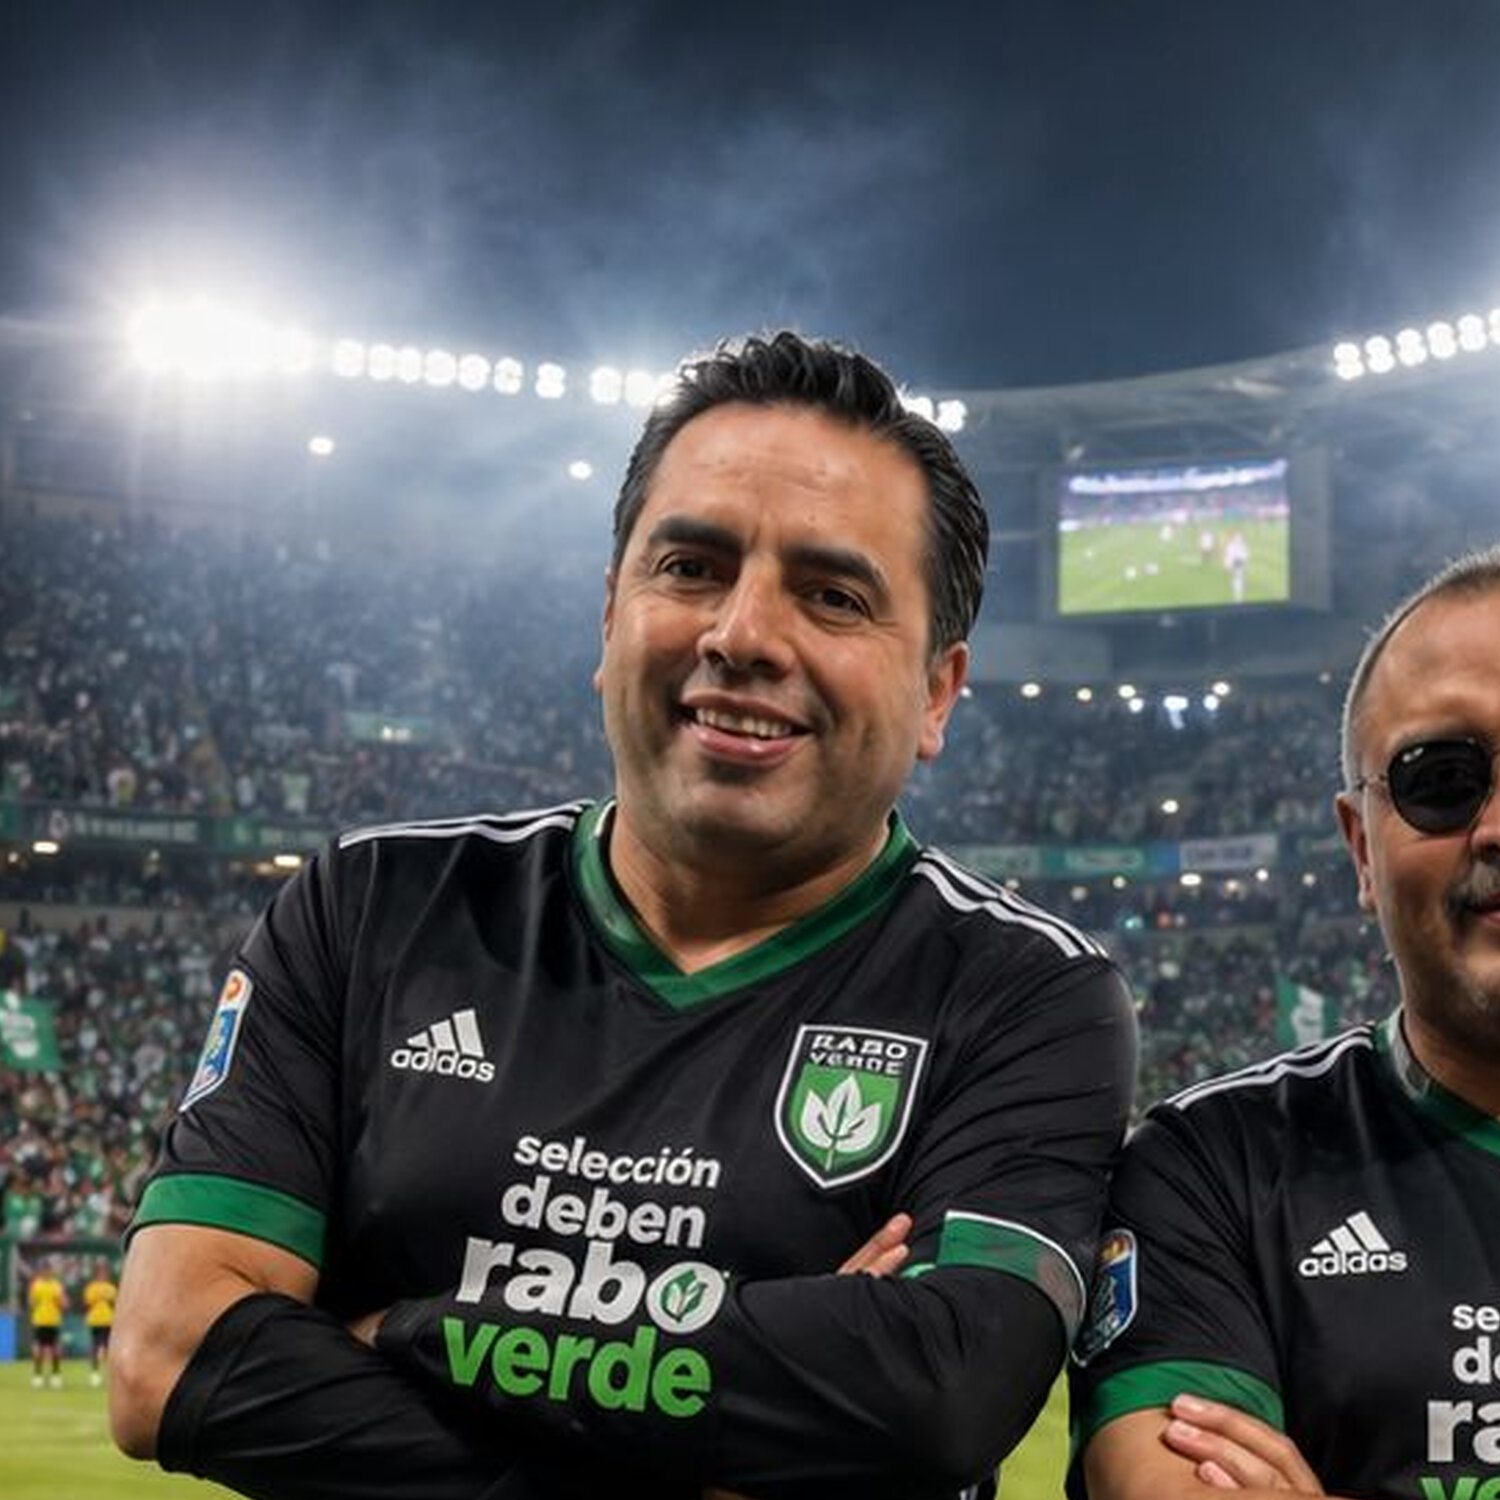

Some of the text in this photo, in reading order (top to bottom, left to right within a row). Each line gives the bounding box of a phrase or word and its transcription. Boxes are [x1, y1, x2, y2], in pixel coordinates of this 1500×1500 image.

[390, 1046, 496, 1083] adidas
[512, 1134, 721, 1188] selección
[500, 1174, 706, 1248] deben
[1298, 1249, 1408, 1277] adidas
[443, 1316, 712, 1418] verde
